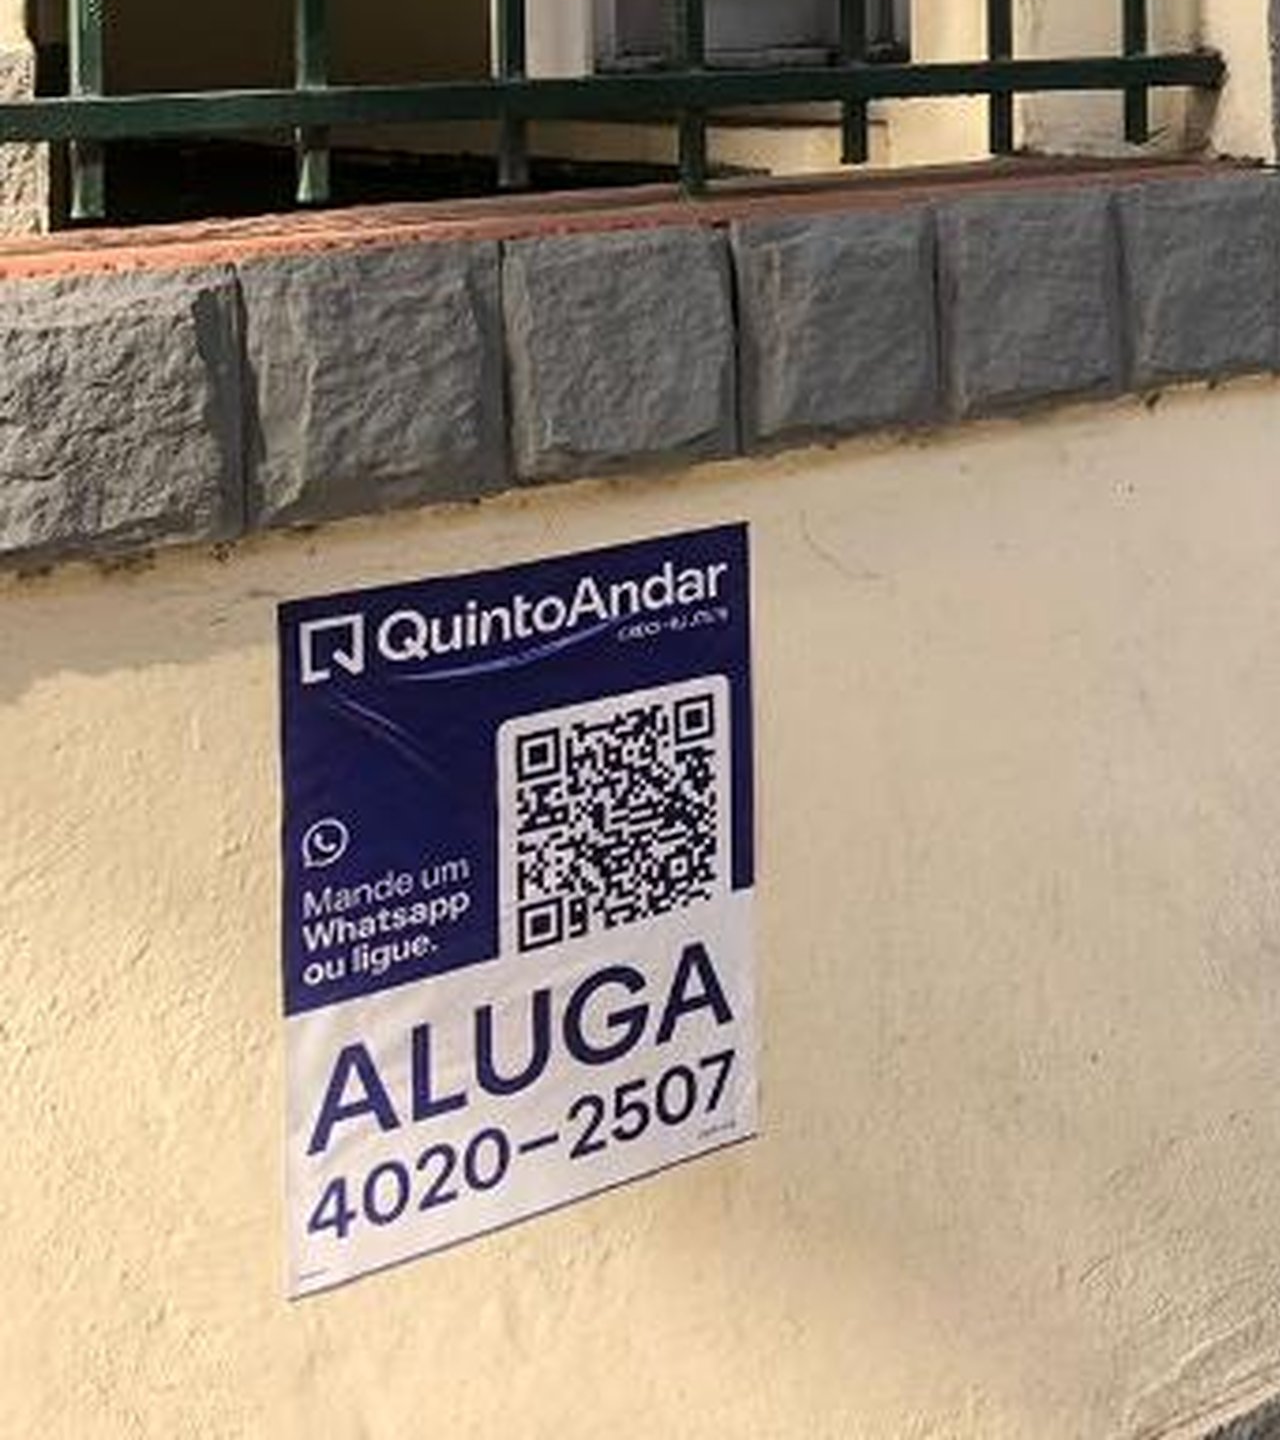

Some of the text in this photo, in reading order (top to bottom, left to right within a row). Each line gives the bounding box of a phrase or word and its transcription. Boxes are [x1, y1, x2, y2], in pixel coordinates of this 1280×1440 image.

[376, 560, 729, 662] QuintoAndar
[302, 858, 470, 920] Mande um
[302, 891, 471, 952] Whatsapp
[303, 933, 439, 985] ou ligue.
[306, 941, 734, 1157] ALUGA
[306, 1048, 736, 1240] 4020-2507
